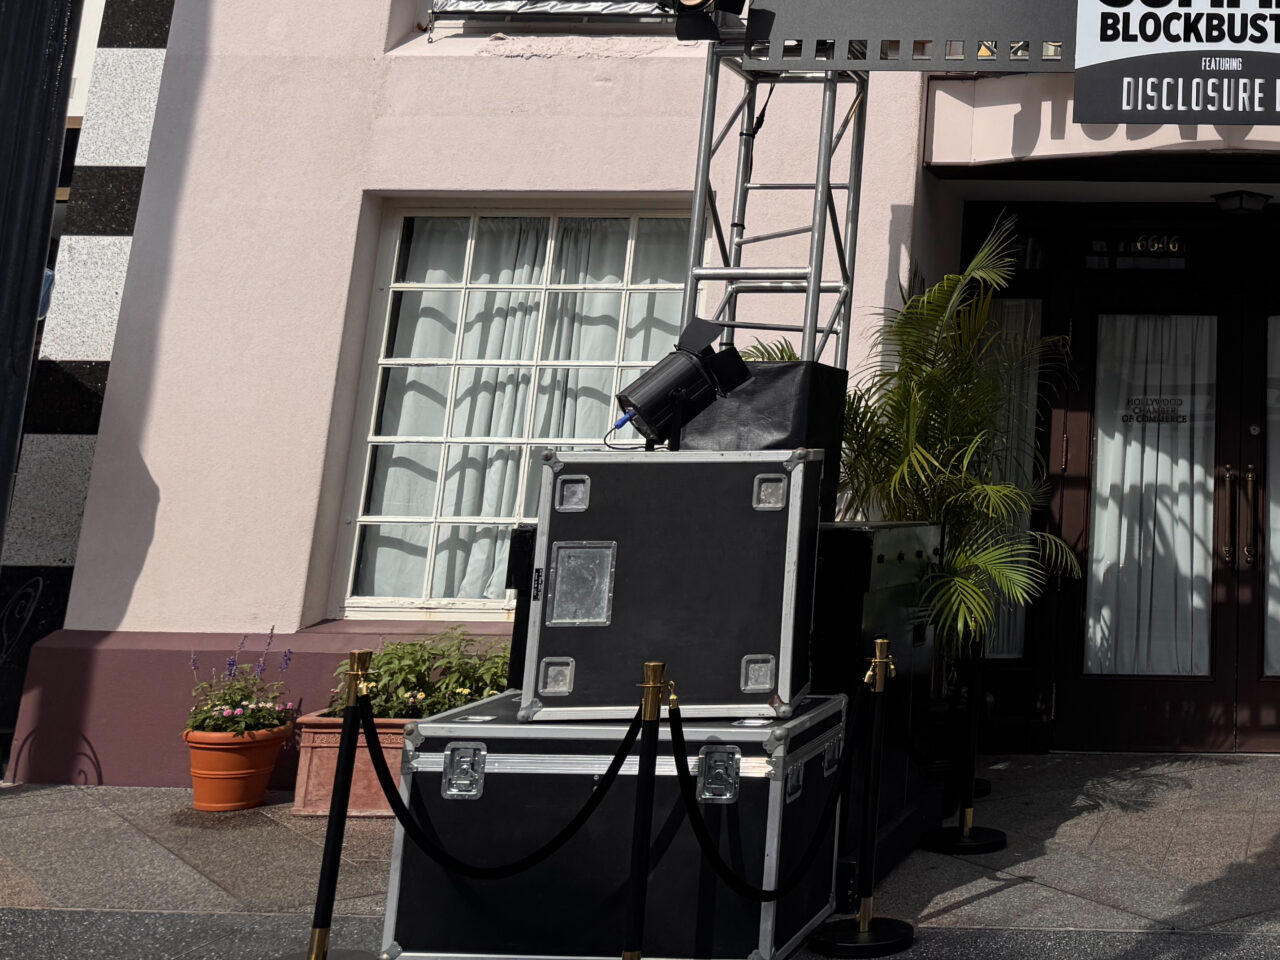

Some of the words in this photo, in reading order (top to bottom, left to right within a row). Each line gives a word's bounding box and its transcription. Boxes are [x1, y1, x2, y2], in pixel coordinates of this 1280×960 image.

[1201, 57, 1242, 71] FEATURING
[1121, 77, 1265, 112] DISCLOSURE
[1121, 415, 1134, 423] OF
[1136, 415, 1187, 424] COMMERCE
